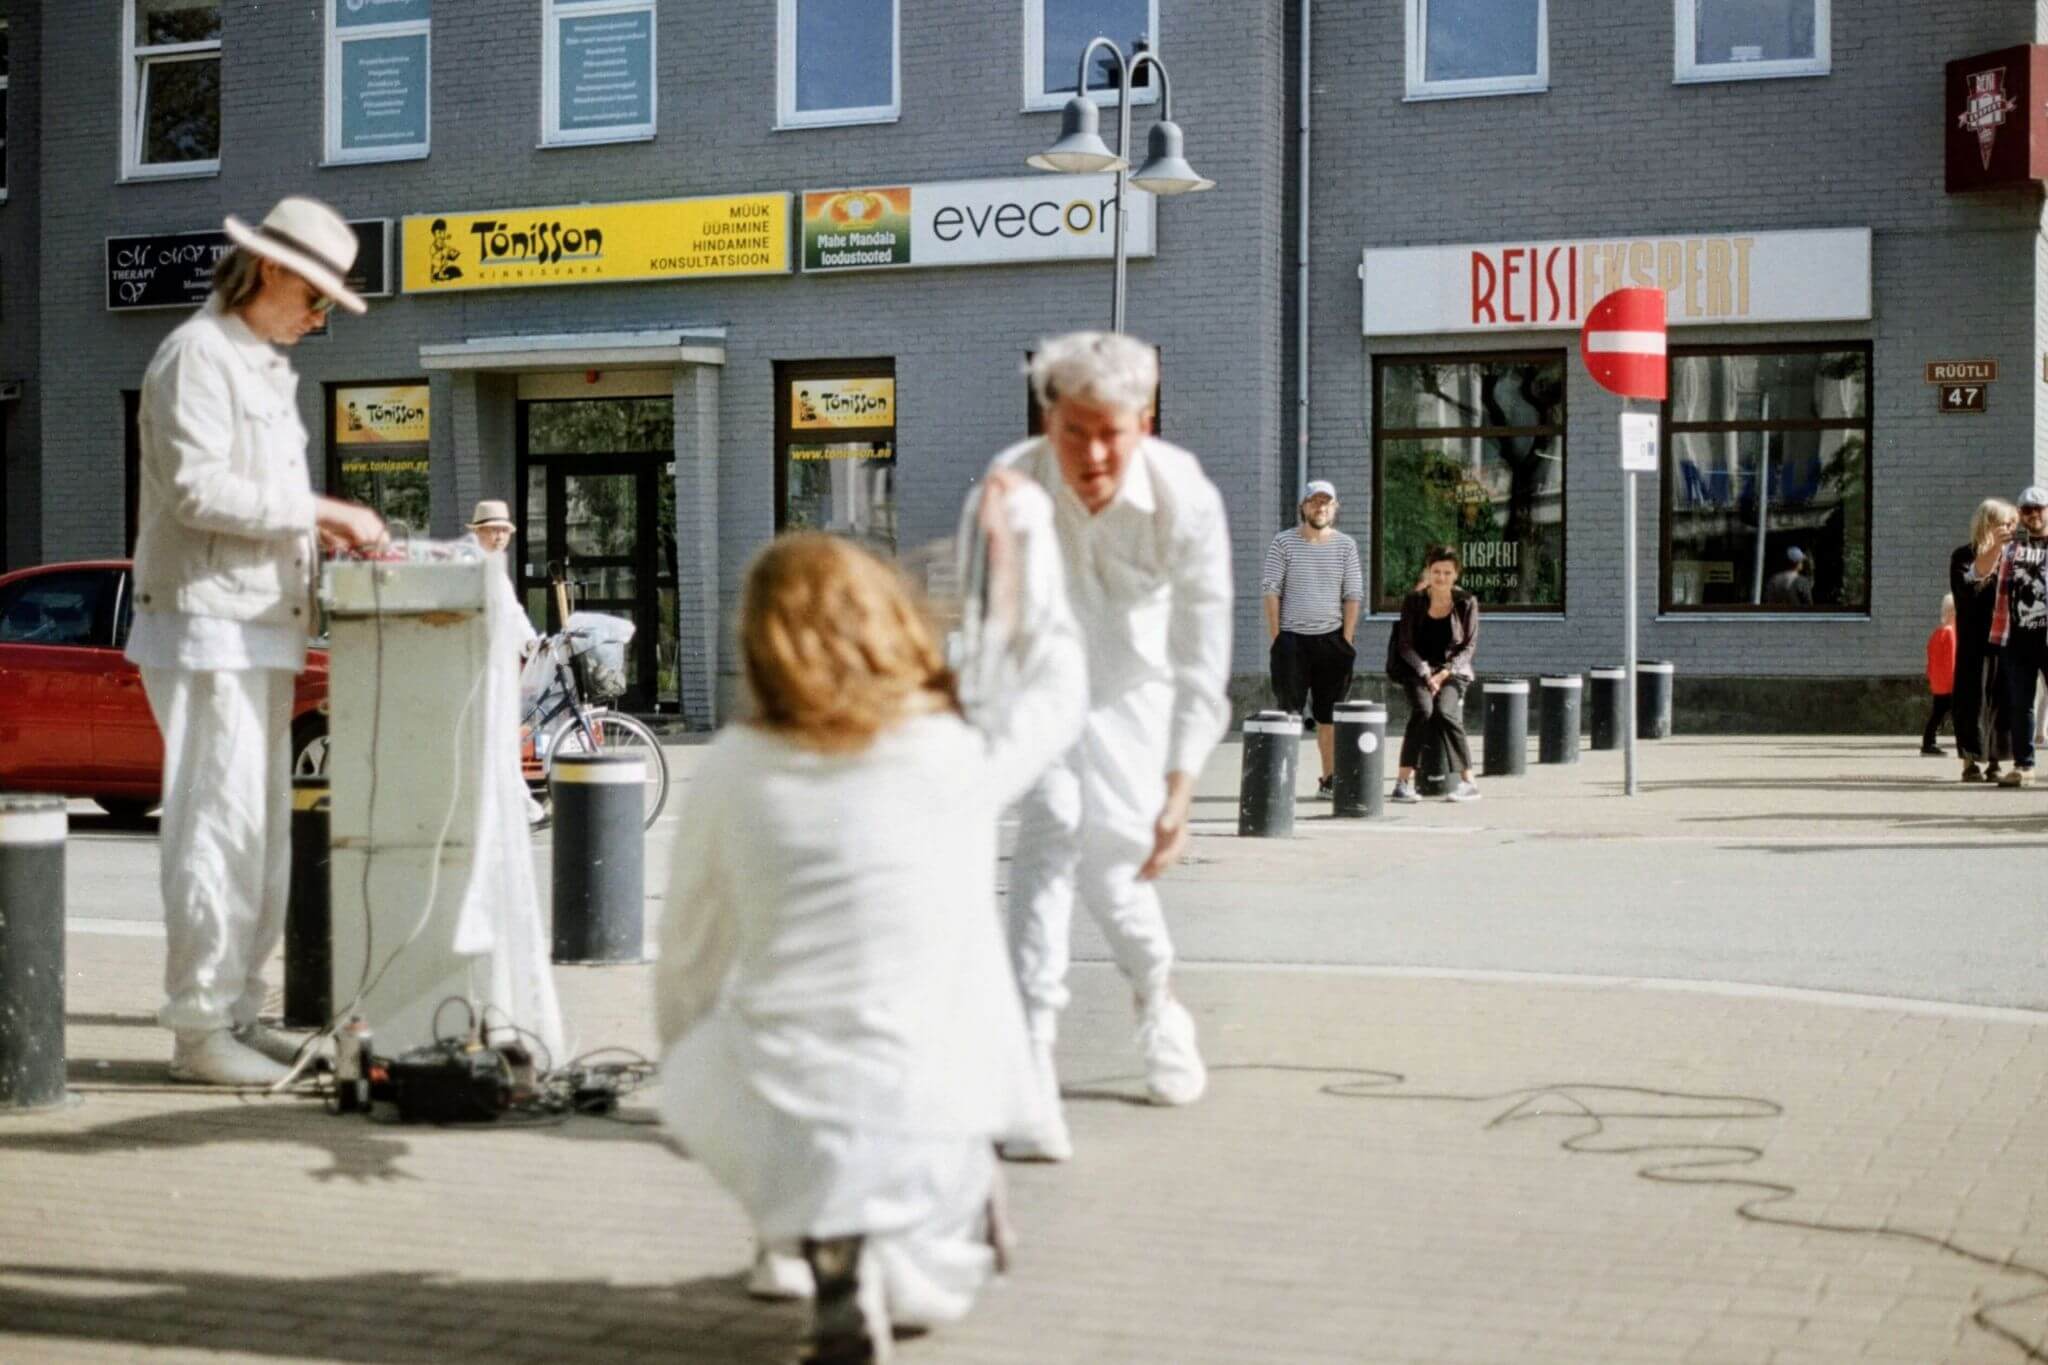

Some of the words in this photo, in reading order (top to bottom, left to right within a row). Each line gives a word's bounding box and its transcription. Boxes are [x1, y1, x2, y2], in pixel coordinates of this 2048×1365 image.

[730, 203, 770, 218] MÜÜK
[702, 220, 769, 236] ÜÜRIMINE
[693, 237, 769, 252] HINDAMINE
[817, 233, 847, 249] Mahe
[849, 231, 896, 247] Mandala
[650, 253, 769, 270] KONSULTATSIOON
[821, 248, 893, 266] loodustooted
[112, 267, 157, 281] THERAPY
[1935, 364, 1989, 378] RÜÜTLI
[1948, 388, 1978, 406] 47
[1462, 541, 1519, 567] EKSPERT
